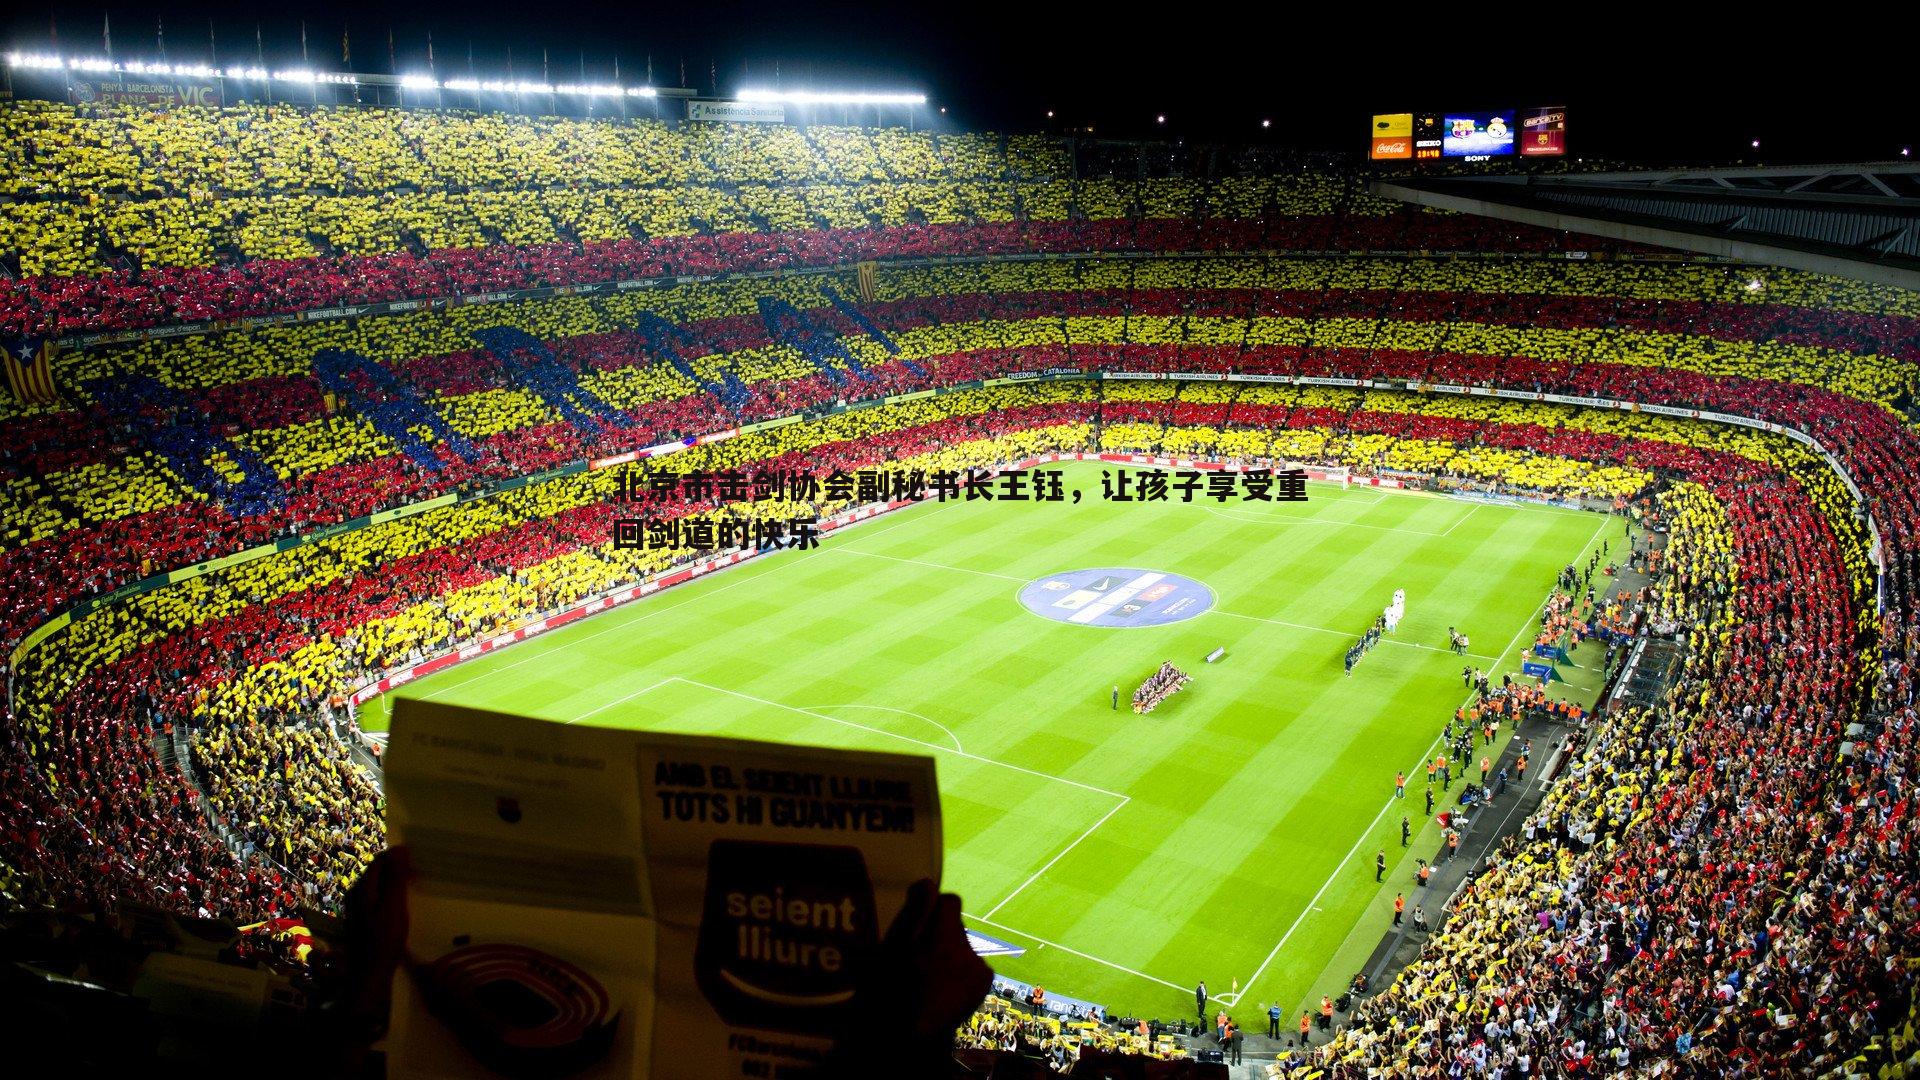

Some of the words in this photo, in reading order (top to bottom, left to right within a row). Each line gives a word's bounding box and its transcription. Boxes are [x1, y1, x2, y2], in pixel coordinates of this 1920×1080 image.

[177, 86, 215, 106] VIC
[307, 307, 357, 320] NIKEFOOTBALL.COM
[1008, 371, 1039, 381] FREEDOM
[1509, 391, 1534, 399] AIRLINES
[1558, 396, 1584, 404] TURKISH
[1662, 407, 1689, 416] AIRLINES
[1714, 414, 1740, 423] TURKISH
[1739, 417, 1763, 428] AIRLINES
[655, 762, 705, 787] AMB
[711, 765, 737, 790] EL
[743, 768, 823, 797] SEIENT
[830, 775, 913, 801] LLIURE
[657, 791, 729, 823] TOTS
[736, 794, 763, 825] HI
[770, 797, 915, 833] GUANYEM!
[725, 883, 856, 933] seient
[737, 924, 844, 974] lliure
